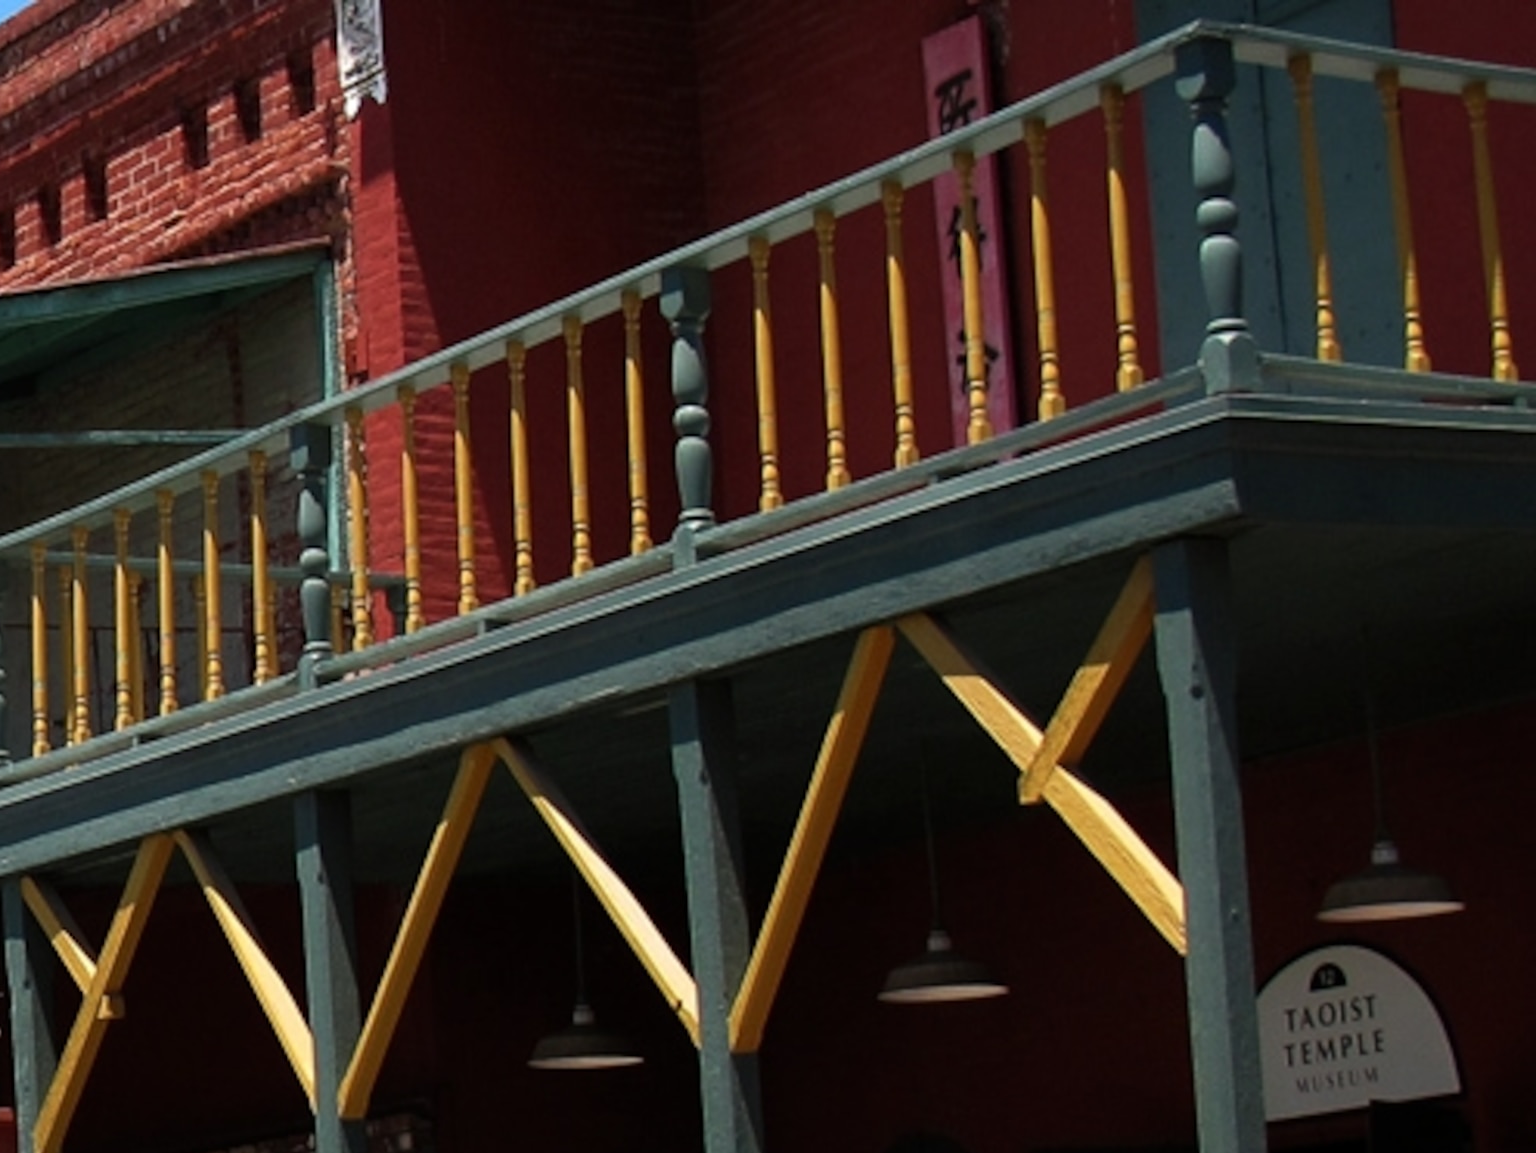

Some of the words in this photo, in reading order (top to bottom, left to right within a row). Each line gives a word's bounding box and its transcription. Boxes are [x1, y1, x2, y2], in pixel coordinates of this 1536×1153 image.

[1285, 995, 1376, 1031] TAOIST
[1284, 1030, 1384, 1066] TEMPLE
[1296, 1067, 1379, 1093] MUSEUM
